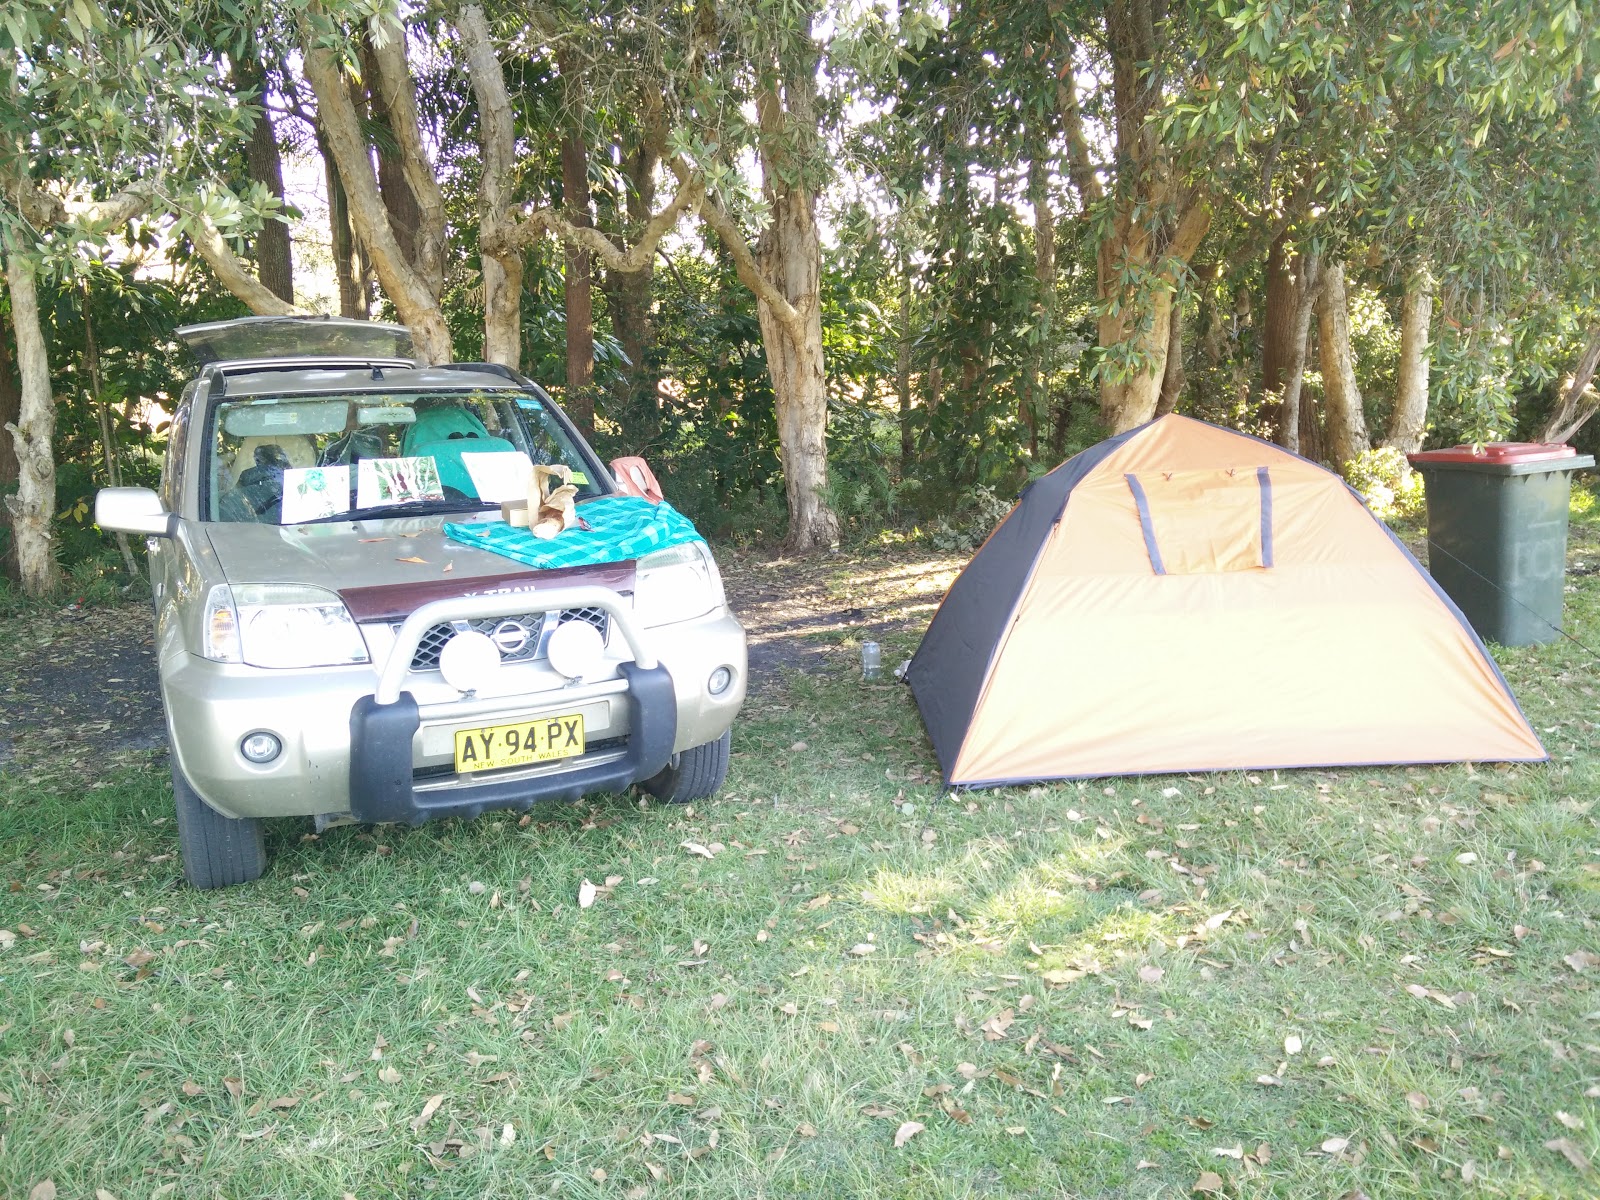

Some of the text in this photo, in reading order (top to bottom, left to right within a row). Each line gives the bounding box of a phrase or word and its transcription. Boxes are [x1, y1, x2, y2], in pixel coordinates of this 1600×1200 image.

[474, 749, 569, 769] NEW SOUTH WALES
